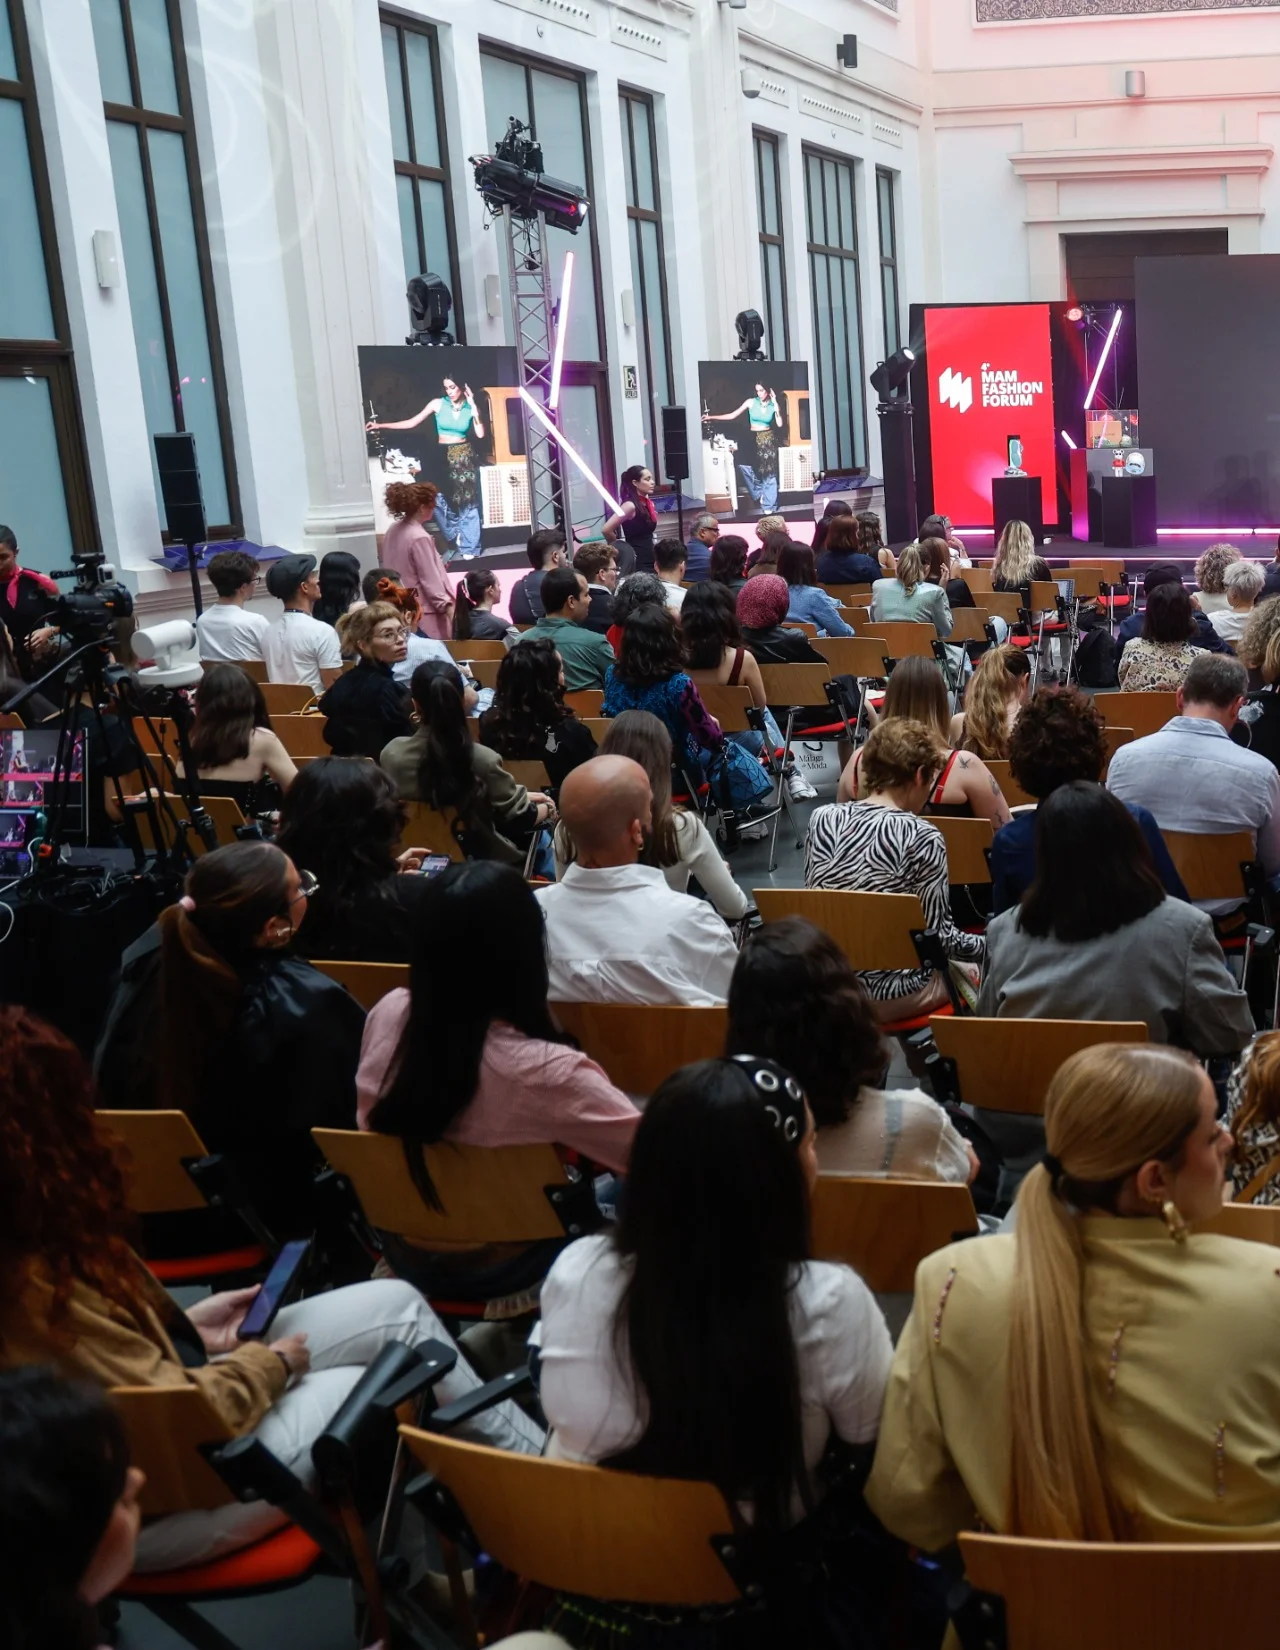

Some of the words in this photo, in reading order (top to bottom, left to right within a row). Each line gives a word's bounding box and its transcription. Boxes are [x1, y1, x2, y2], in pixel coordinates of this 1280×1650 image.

[981, 370, 1018, 383] MAM
[982, 381, 1043, 395] FASHION
[982, 393, 1033, 408] FORUM
[799, 753, 824, 763] Málaga
[807, 761, 828, 769] Moda
